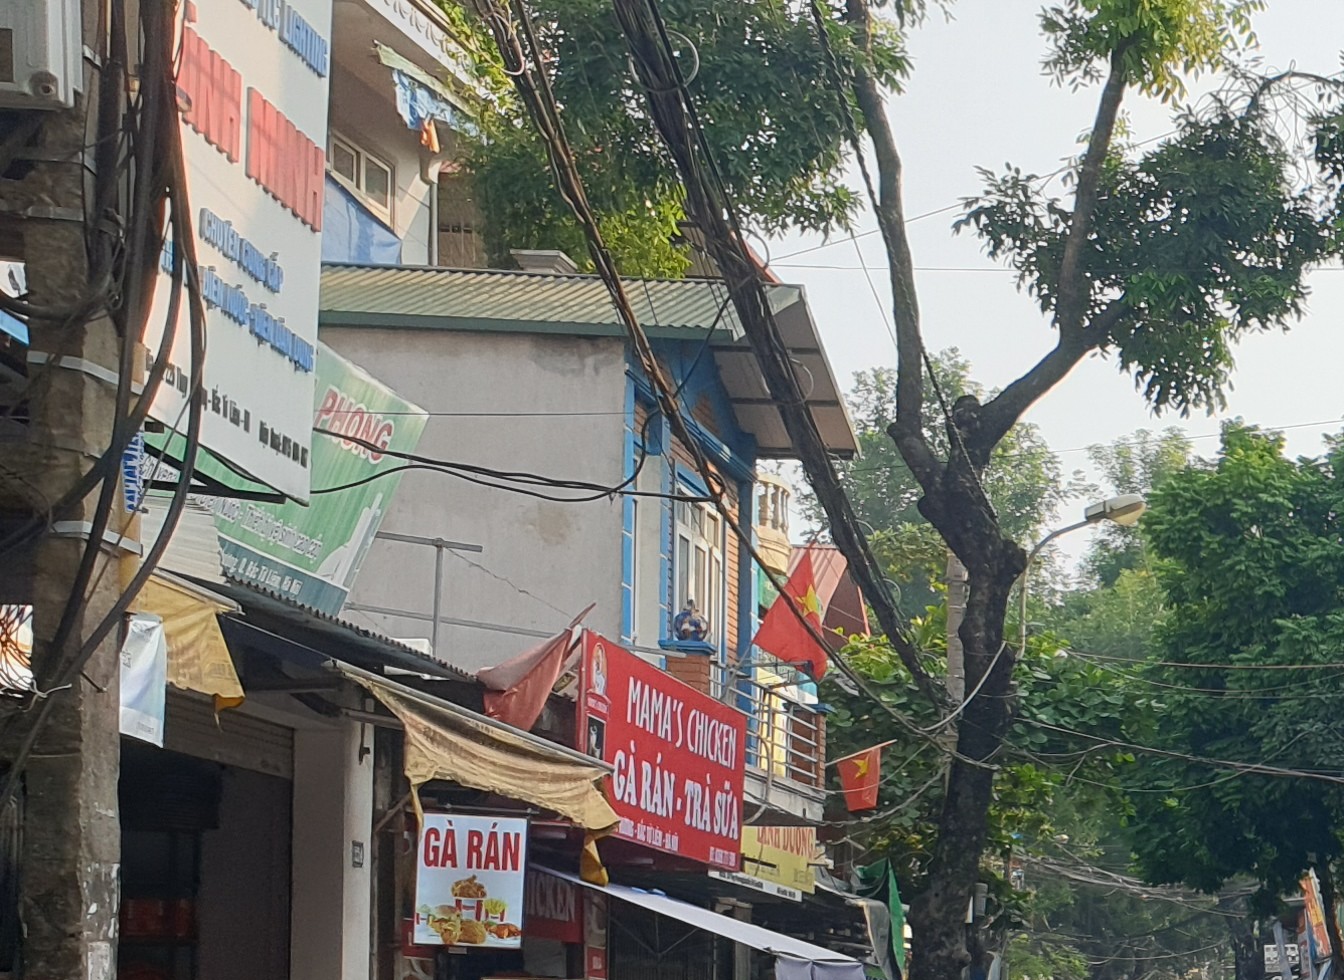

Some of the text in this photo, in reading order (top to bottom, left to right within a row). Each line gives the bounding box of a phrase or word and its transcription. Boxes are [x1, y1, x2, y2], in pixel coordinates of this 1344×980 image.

[246, 87, 325, 232] MINH
[313, 384, 395, 466] PHONG
[627, 676, 737, 770] MAMA'S CHICKEN
[612, 739, 739, 841] GÀ RÁN TRÀ SỮA
[424, 820, 520, 871] GÀ RÁN
[527, 872, 576, 922] ICKEN
